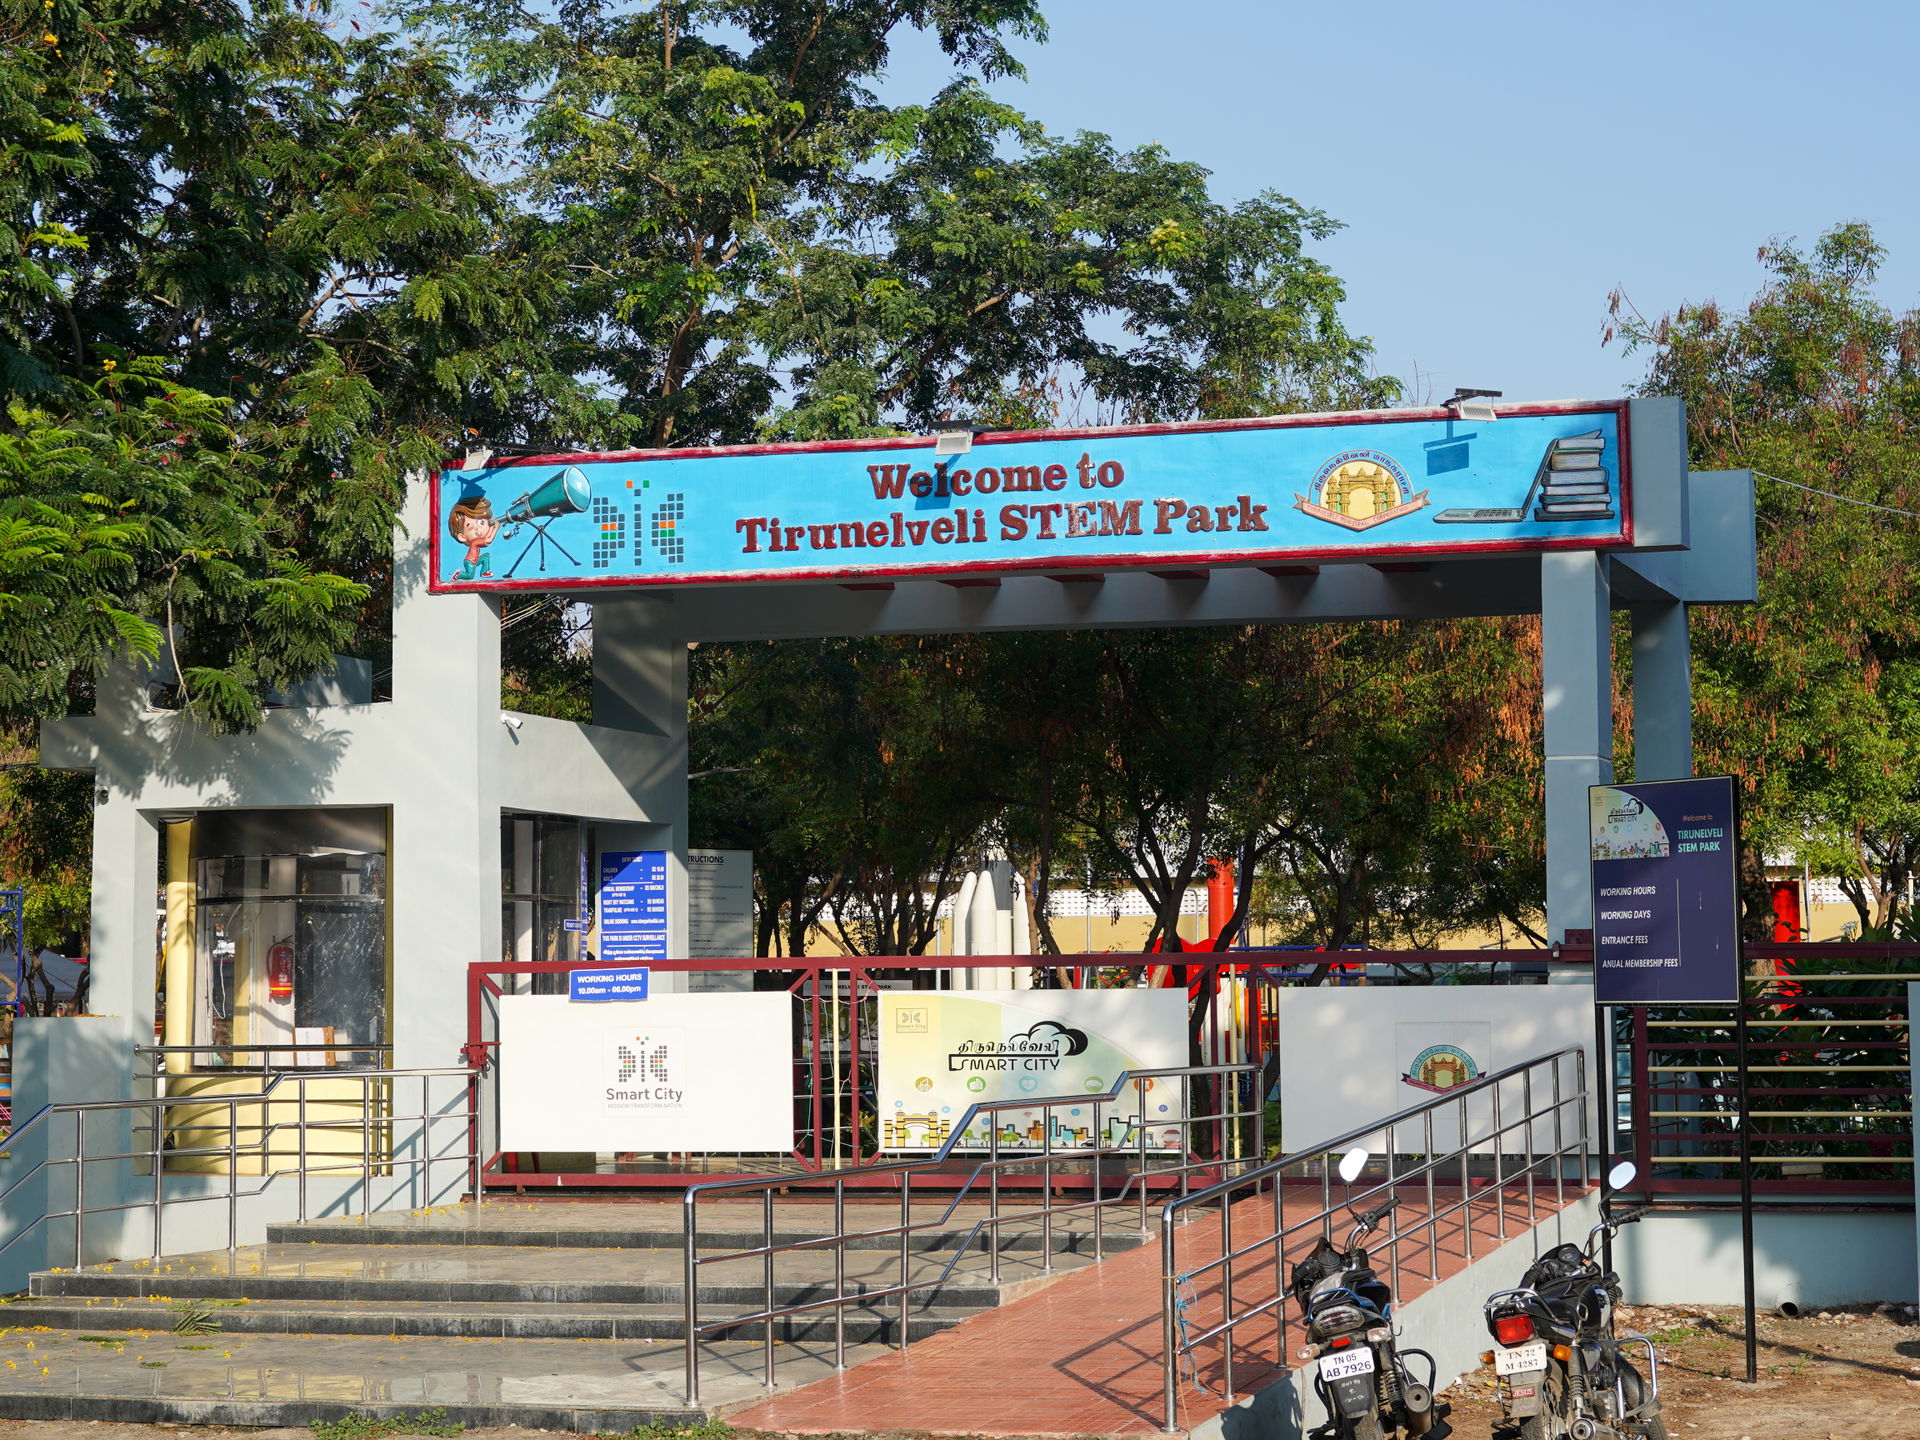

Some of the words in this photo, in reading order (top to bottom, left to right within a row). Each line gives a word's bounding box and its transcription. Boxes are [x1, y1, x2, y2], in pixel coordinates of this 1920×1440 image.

[866, 461, 1068, 500] Welcome
[1076, 452, 1125, 489] to
[736, 507, 988, 553] Tirunelveli
[1000, 499, 1144, 541] STEM
[1153, 494, 1270, 534] Park
[1677, 828, 1724, 840] TIRUNELVELI
[1677, 842, 1699, 853] STEM
[1699, 841, 1721, 852] PARK
[1600, 887, 1632, 897] WORKING
[1632, 886, 1656, 895] HOURS
[1601, 910, 1633, 920] WORKING
[1633, 910, 1651, 919] DAYS
[1601, 936, 1634, 945] ENTRANCE
[1634, 935, 1649, 944] FEES
[1602, 959, 1624, 968] ANUAL
[1624, 958, 1664, 968] MEMBERSHIP
[1663, 958, 1679, 968] FEES
[577, 974, 615, 984] WORKING
[615, 973, 643, 982] HOURS
[577, 986, 607, 995] 10.00am
[953, 1058, 1018, 1071] SMART
[1023, 1058, 1061, 1071] CITY
[606, 1087, 650, 1101] Smart
[654, 1087, 683, 1103] City
[1333, 1356, 1345, 1365] TN
[1345, 1353, 1357, 1363] 05
[1506, 1351, 1522, 1360] TN
[1525, 1349, 1536, 1357] 72
[1326, 1367, 1341, 1378] AB
[1342, 1361, 1372, 1375] 7926
[1505, 1363, 1515, 1371] M
[1517, 1359, 1539, 1369] 4287
[1514, 1387, 1534, 1397] JESUS
